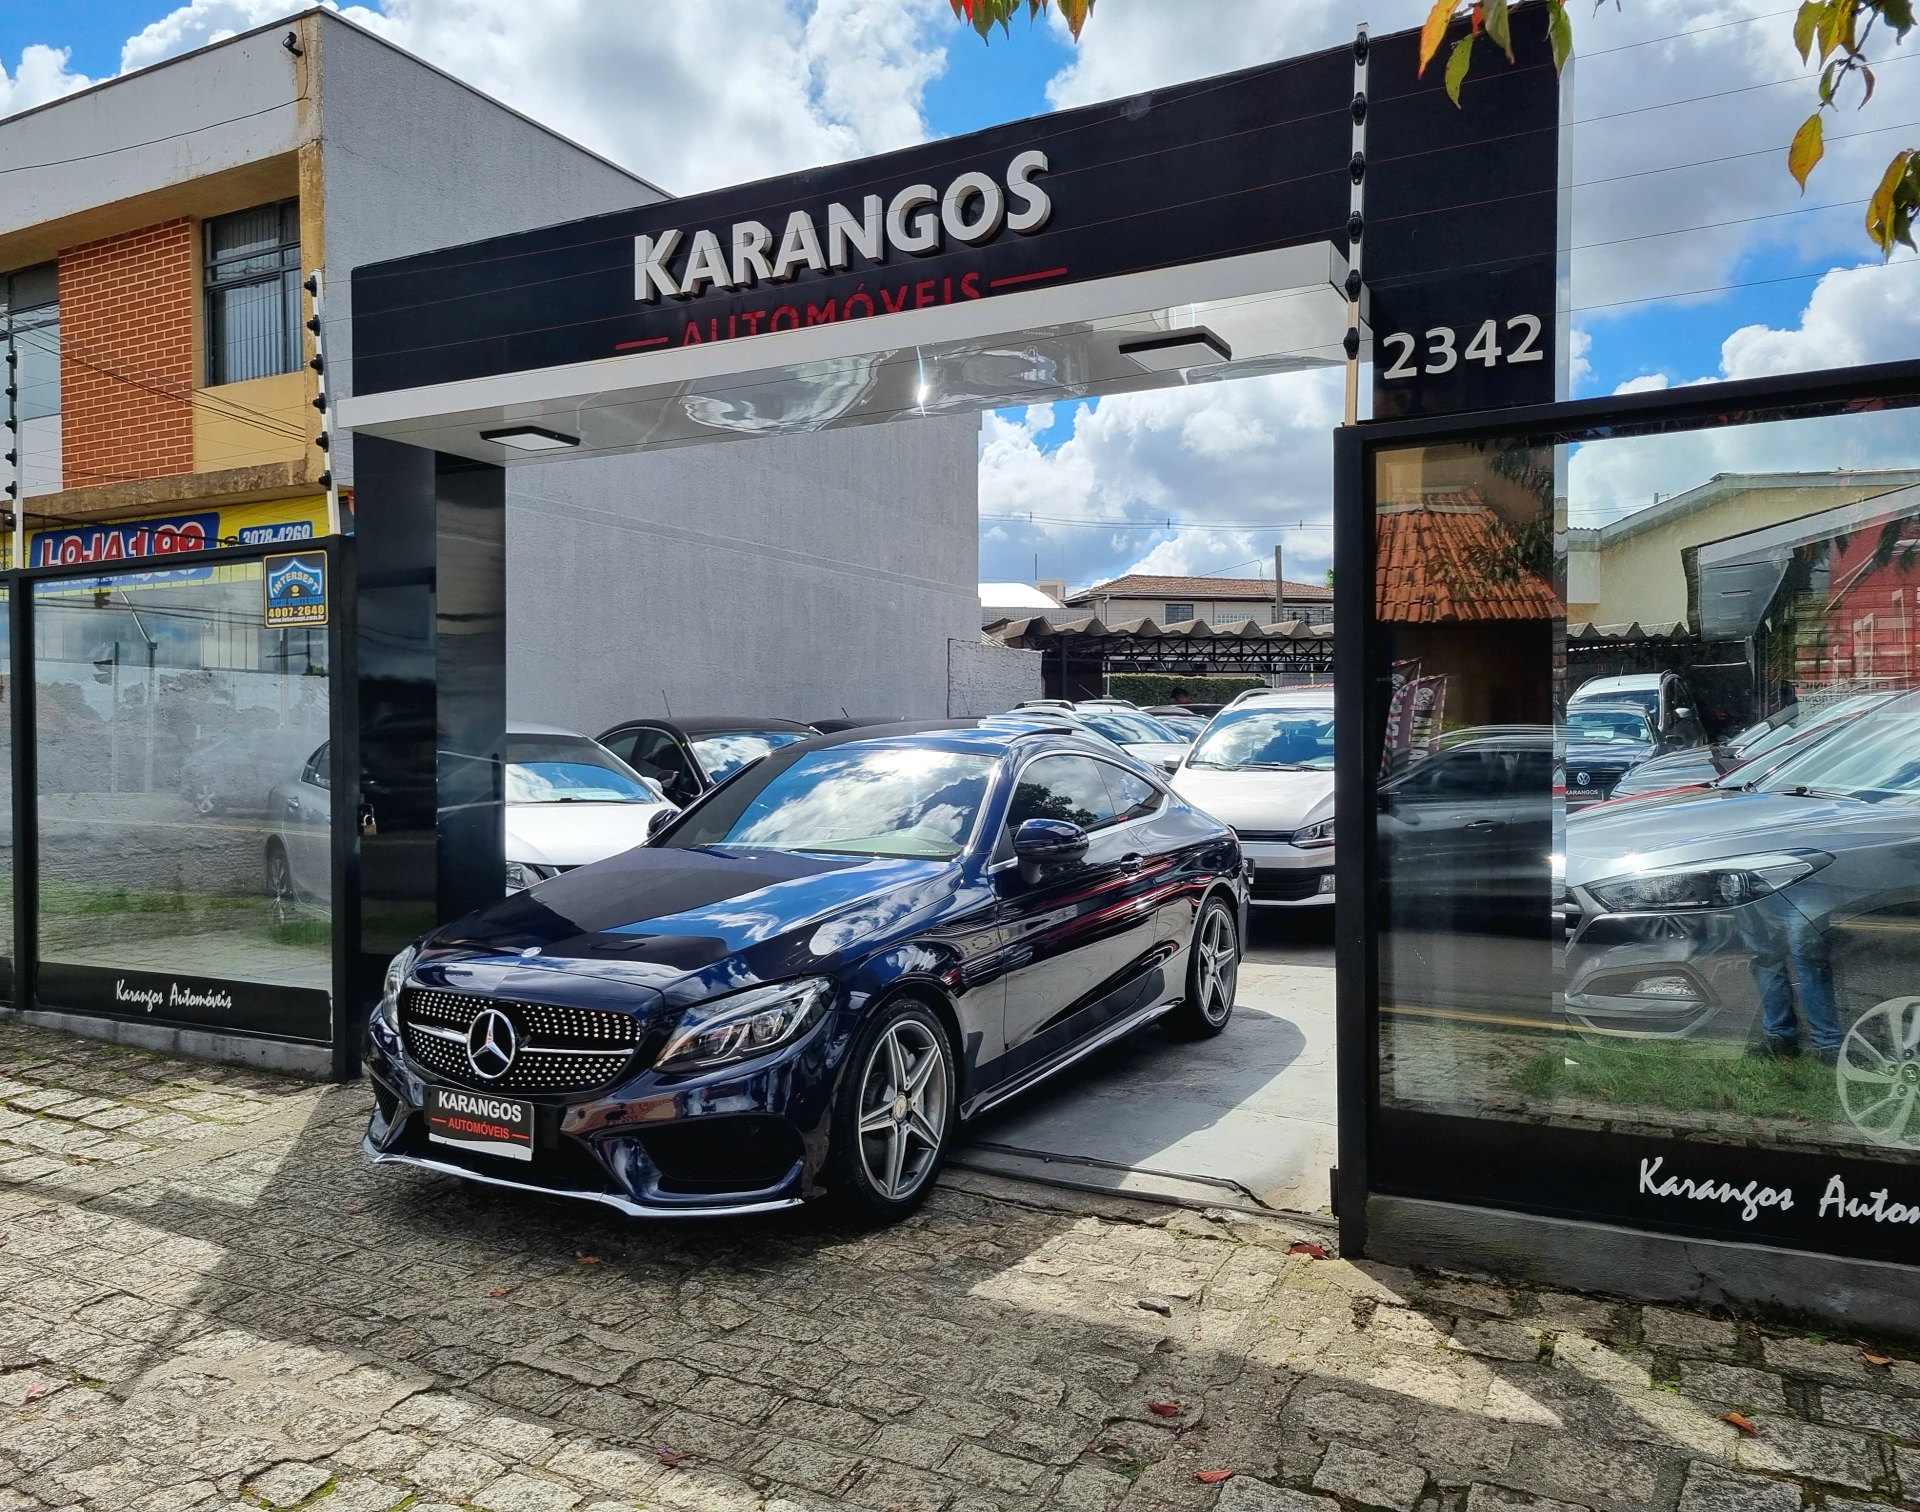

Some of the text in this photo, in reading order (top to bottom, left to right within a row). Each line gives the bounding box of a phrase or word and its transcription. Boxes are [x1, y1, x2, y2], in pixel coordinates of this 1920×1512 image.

[634, 150, 1052, 302] KARANGOS
[682, 271, 981, 347] AUTOMÓVEIS
[1383, 314, 1544, 380] 2342
[40, 530, 125, 568] LOJA
[273, 571, 319, 594] INTERSEPT
[269, 605, 324, 617] 4007-2640
[116, 979, 232, 1012] Karangos Automóveis
[439, 1090, 522, 1122] KARANGOS
[448, 1117, 510, 1139] AUTOMÓVEIS
[1639, 1156, 1795, 1221] Karangos
